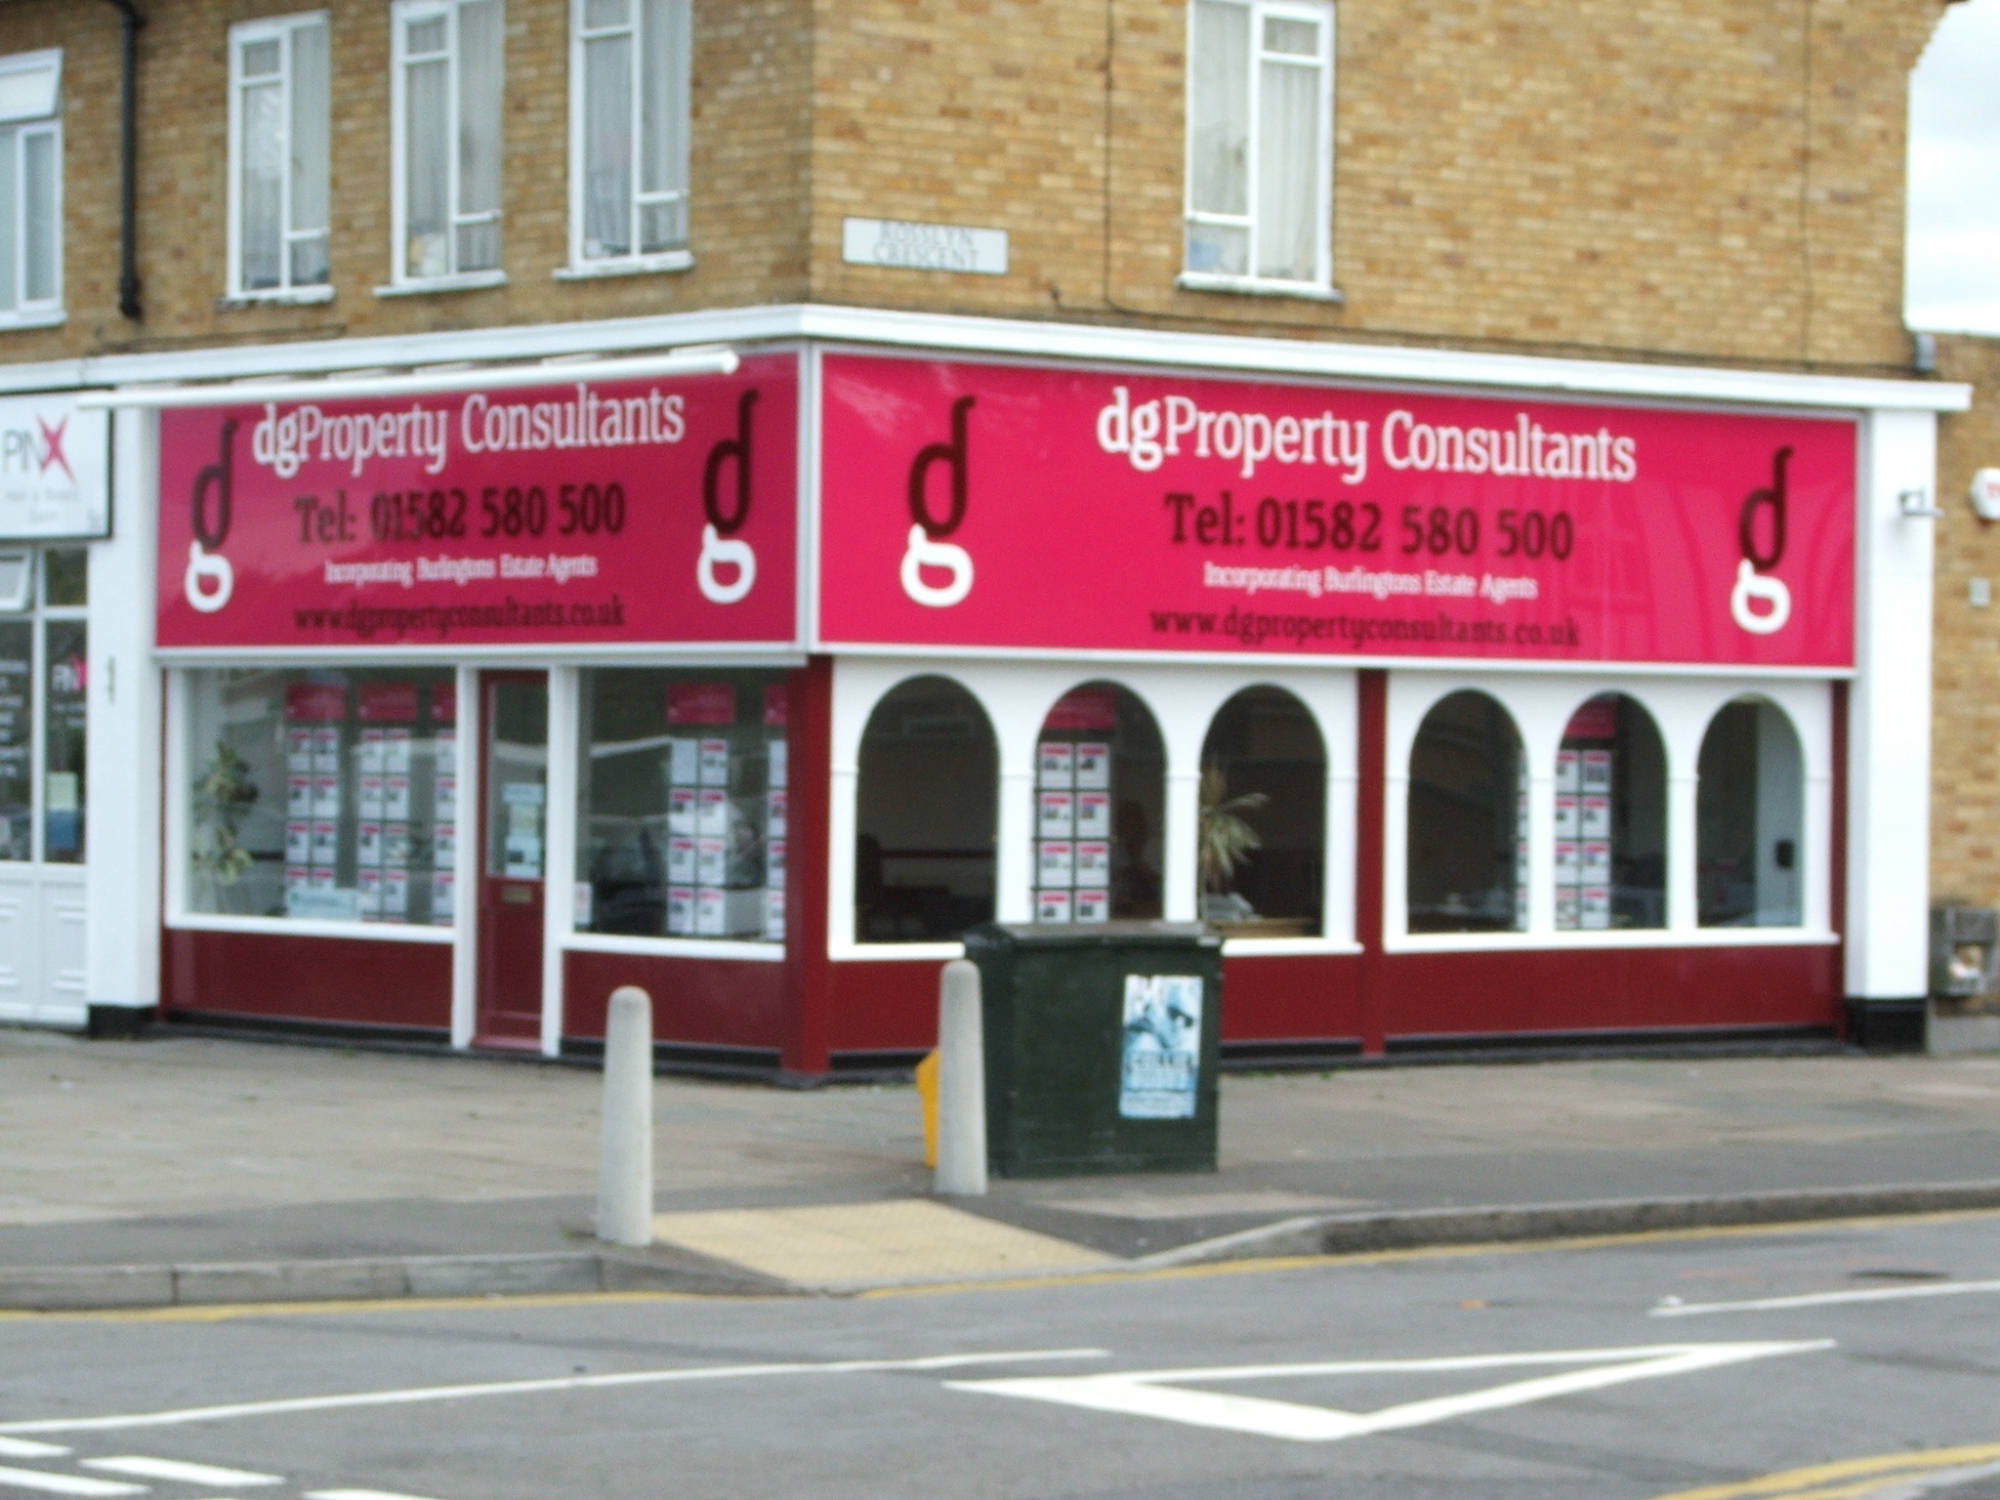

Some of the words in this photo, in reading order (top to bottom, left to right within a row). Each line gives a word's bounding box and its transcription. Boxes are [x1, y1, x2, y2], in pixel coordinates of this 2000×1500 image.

[873, 240, 980, 271] CRESCENT
[252, 401, 448, 479] dgProperty
[461, 381, 685, 454] Consultants
[1097, 385, 1369, 485] dgProperty
[1381, 408, 1638, 482] Consultants
[294, 489, 357, 543] Tel:
[370, 486, 468, 541] 01582
[481, 485, 548, 539] 580
[558, 482, 627, 536] 500
[1164, 490, 1246, 546] Tel:
[1256, 496, 1383, 552] 01582
[1402, 505, 1481, 557] 580
[1498, 507, 1575, 562] 500
[324, 557, 414, 588] Incorporating
[499, 553, 546, 579] Estate
[547, 553, 598, 585] Agents
[1203, 560, 1323, 599] Incorporating
[1424, 569, 1478, 598] Estate
[1479, 572, 1540, 605] Agents
[294, 592, 626, 638] www.dgpropertyconsultants.co.uk
[1149, 603, 1582, 650] www.dgpropertyconsultants.co.uk
